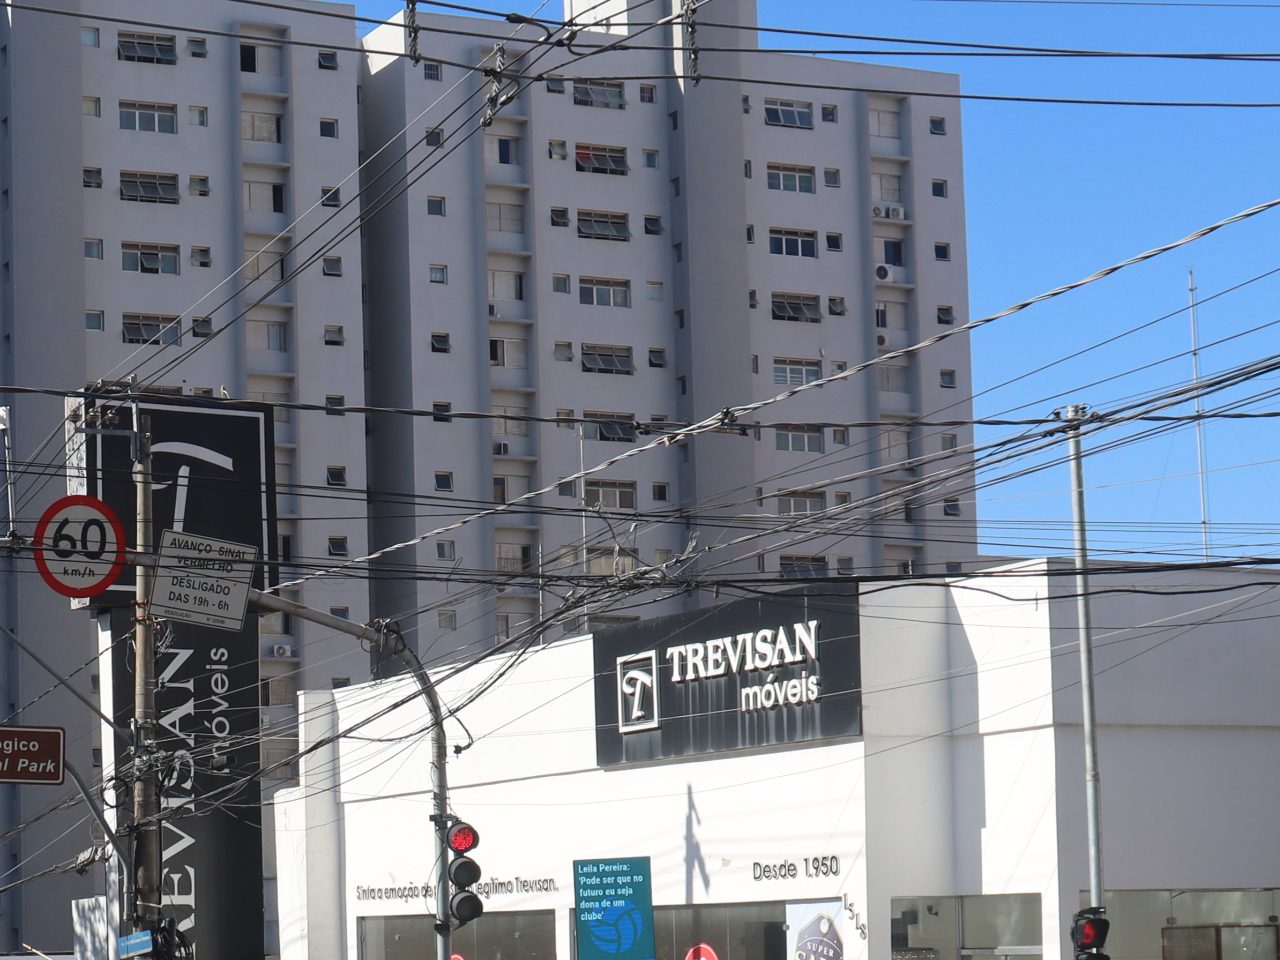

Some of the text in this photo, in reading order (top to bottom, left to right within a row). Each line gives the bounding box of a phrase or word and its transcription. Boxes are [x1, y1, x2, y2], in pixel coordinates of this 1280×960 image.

[53, 517, 106, 560] 60
[170, 538, 246, 560] AVANÇO SINAL
[63, 566, 95, 578] km/h
[171, 576, 231, 596] DESLIGADO
[168, 591, 190, 603] DAS
[193, 596, 209, 608] 19h
[218, 600, 229, 611] 6h
[666, 620, 818, 682] TREVISAN
[742, 671, 819, 711] móveis
[17, 758, 55, 773] Park
[578, 862, 631, 873] Leila Pereira:
[753, 861, 797, 880] Desde
[602, 876, 615, 884] ser
[616, 875, 632, 885] que
[579, 886, 633, 897] futuro eu seja
[580, 899, 625, 909] dona de um
[806, 941, 834, 958] SUPER
